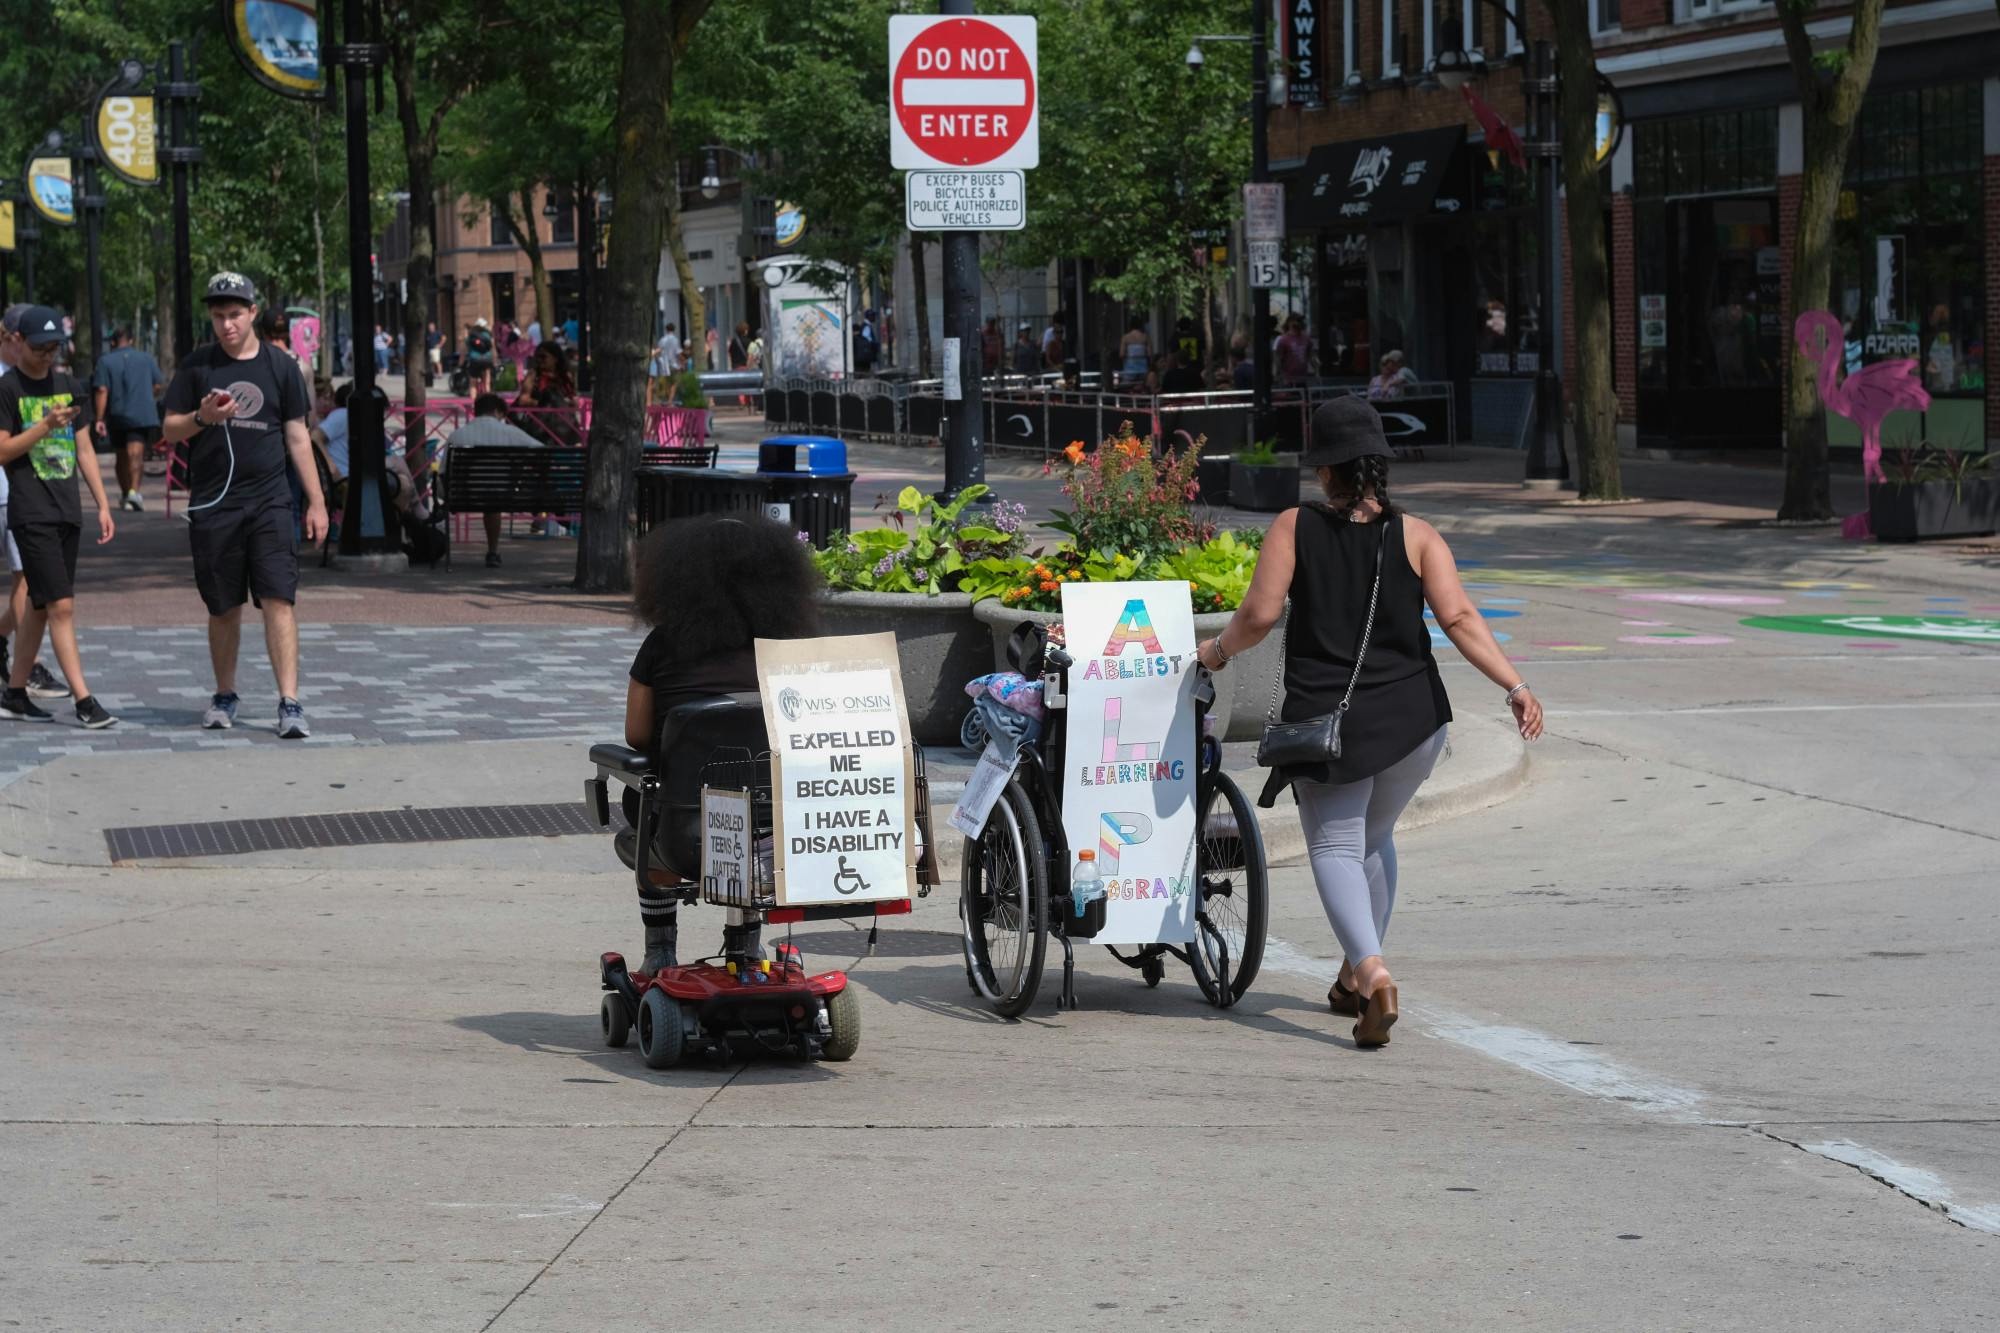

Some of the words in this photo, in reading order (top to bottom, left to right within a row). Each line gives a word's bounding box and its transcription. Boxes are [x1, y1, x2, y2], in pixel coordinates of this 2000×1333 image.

[917, 48, 951, 72] DO
[960, 48, 1010, 72] NOT
[106, 97, 136, 166] 400
[920, 114, 1009, 137] ENTER
[137, 112, 154, 165] BLOCK
[926, 175, 967, 186] EXCEPT
[970, 175, 1005, 186] BUSES
[935, 187, 984, 199] BICYCLES
[989, 187, 996, 199] &
[913, 200, 949, 211] POLICE
[954, 199, 1018, 211] AUTHORIZED
[942, 212, 992, 224] VEHICLES
[1250, 244, 1277, 254] SPEED
[1252, 254, 1274, 263] LIMIT
[1253, 264, 1275, 284] 15
[1865, 334, 1920, 354] AZARA
[1102, 599, 1164, 656] A
[1083, 655, 1182, 680] ABLEIST
[804, 695, 891, 710] WISONSIN
[789, 730, 896, 750] EXPELLED
[1101, 697, 1160, 763] L
[829, 754, 862, 772] ME
[1080, 760, 1185, 786] LEARNING
[796, 777, 896, 798] BECAUSE
[708, 811, 744, 832] DISABLED
[804, 812, 810, 829] I
[816, 809, 872, 829] HAVE
[876, 808, 890, 826] A
[710, 835, 732, 855] TEENS
[791, 832, 903, 855] DISABILITY
[1099, 811, 1153, 876] P
[712, 859, 741, 881] MATTER
[1107, 876, 1192, 900] OGRAM
